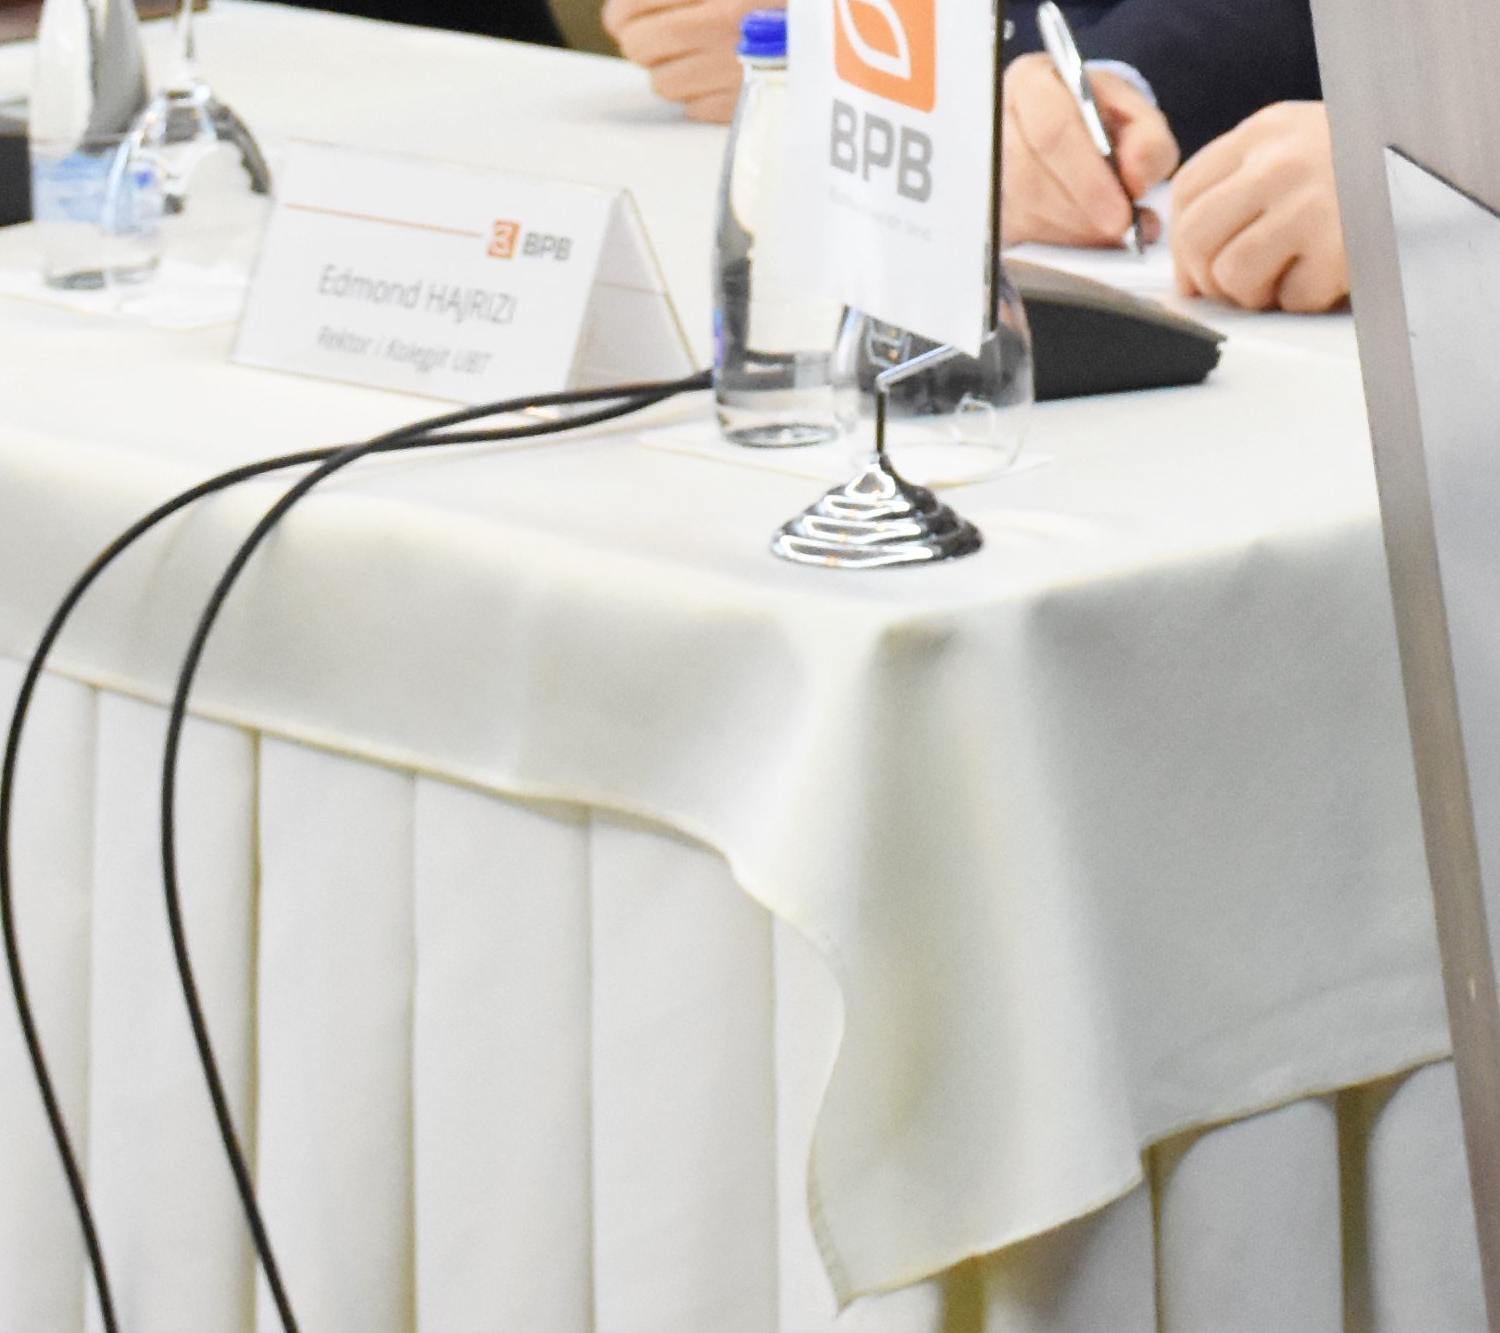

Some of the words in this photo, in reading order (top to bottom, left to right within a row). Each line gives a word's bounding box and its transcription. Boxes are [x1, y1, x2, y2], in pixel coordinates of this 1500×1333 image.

[830, 98, 933, 205] BPB
[522, 231, 573, 261] BPB
[317, 263, 422, 310] Edmond
